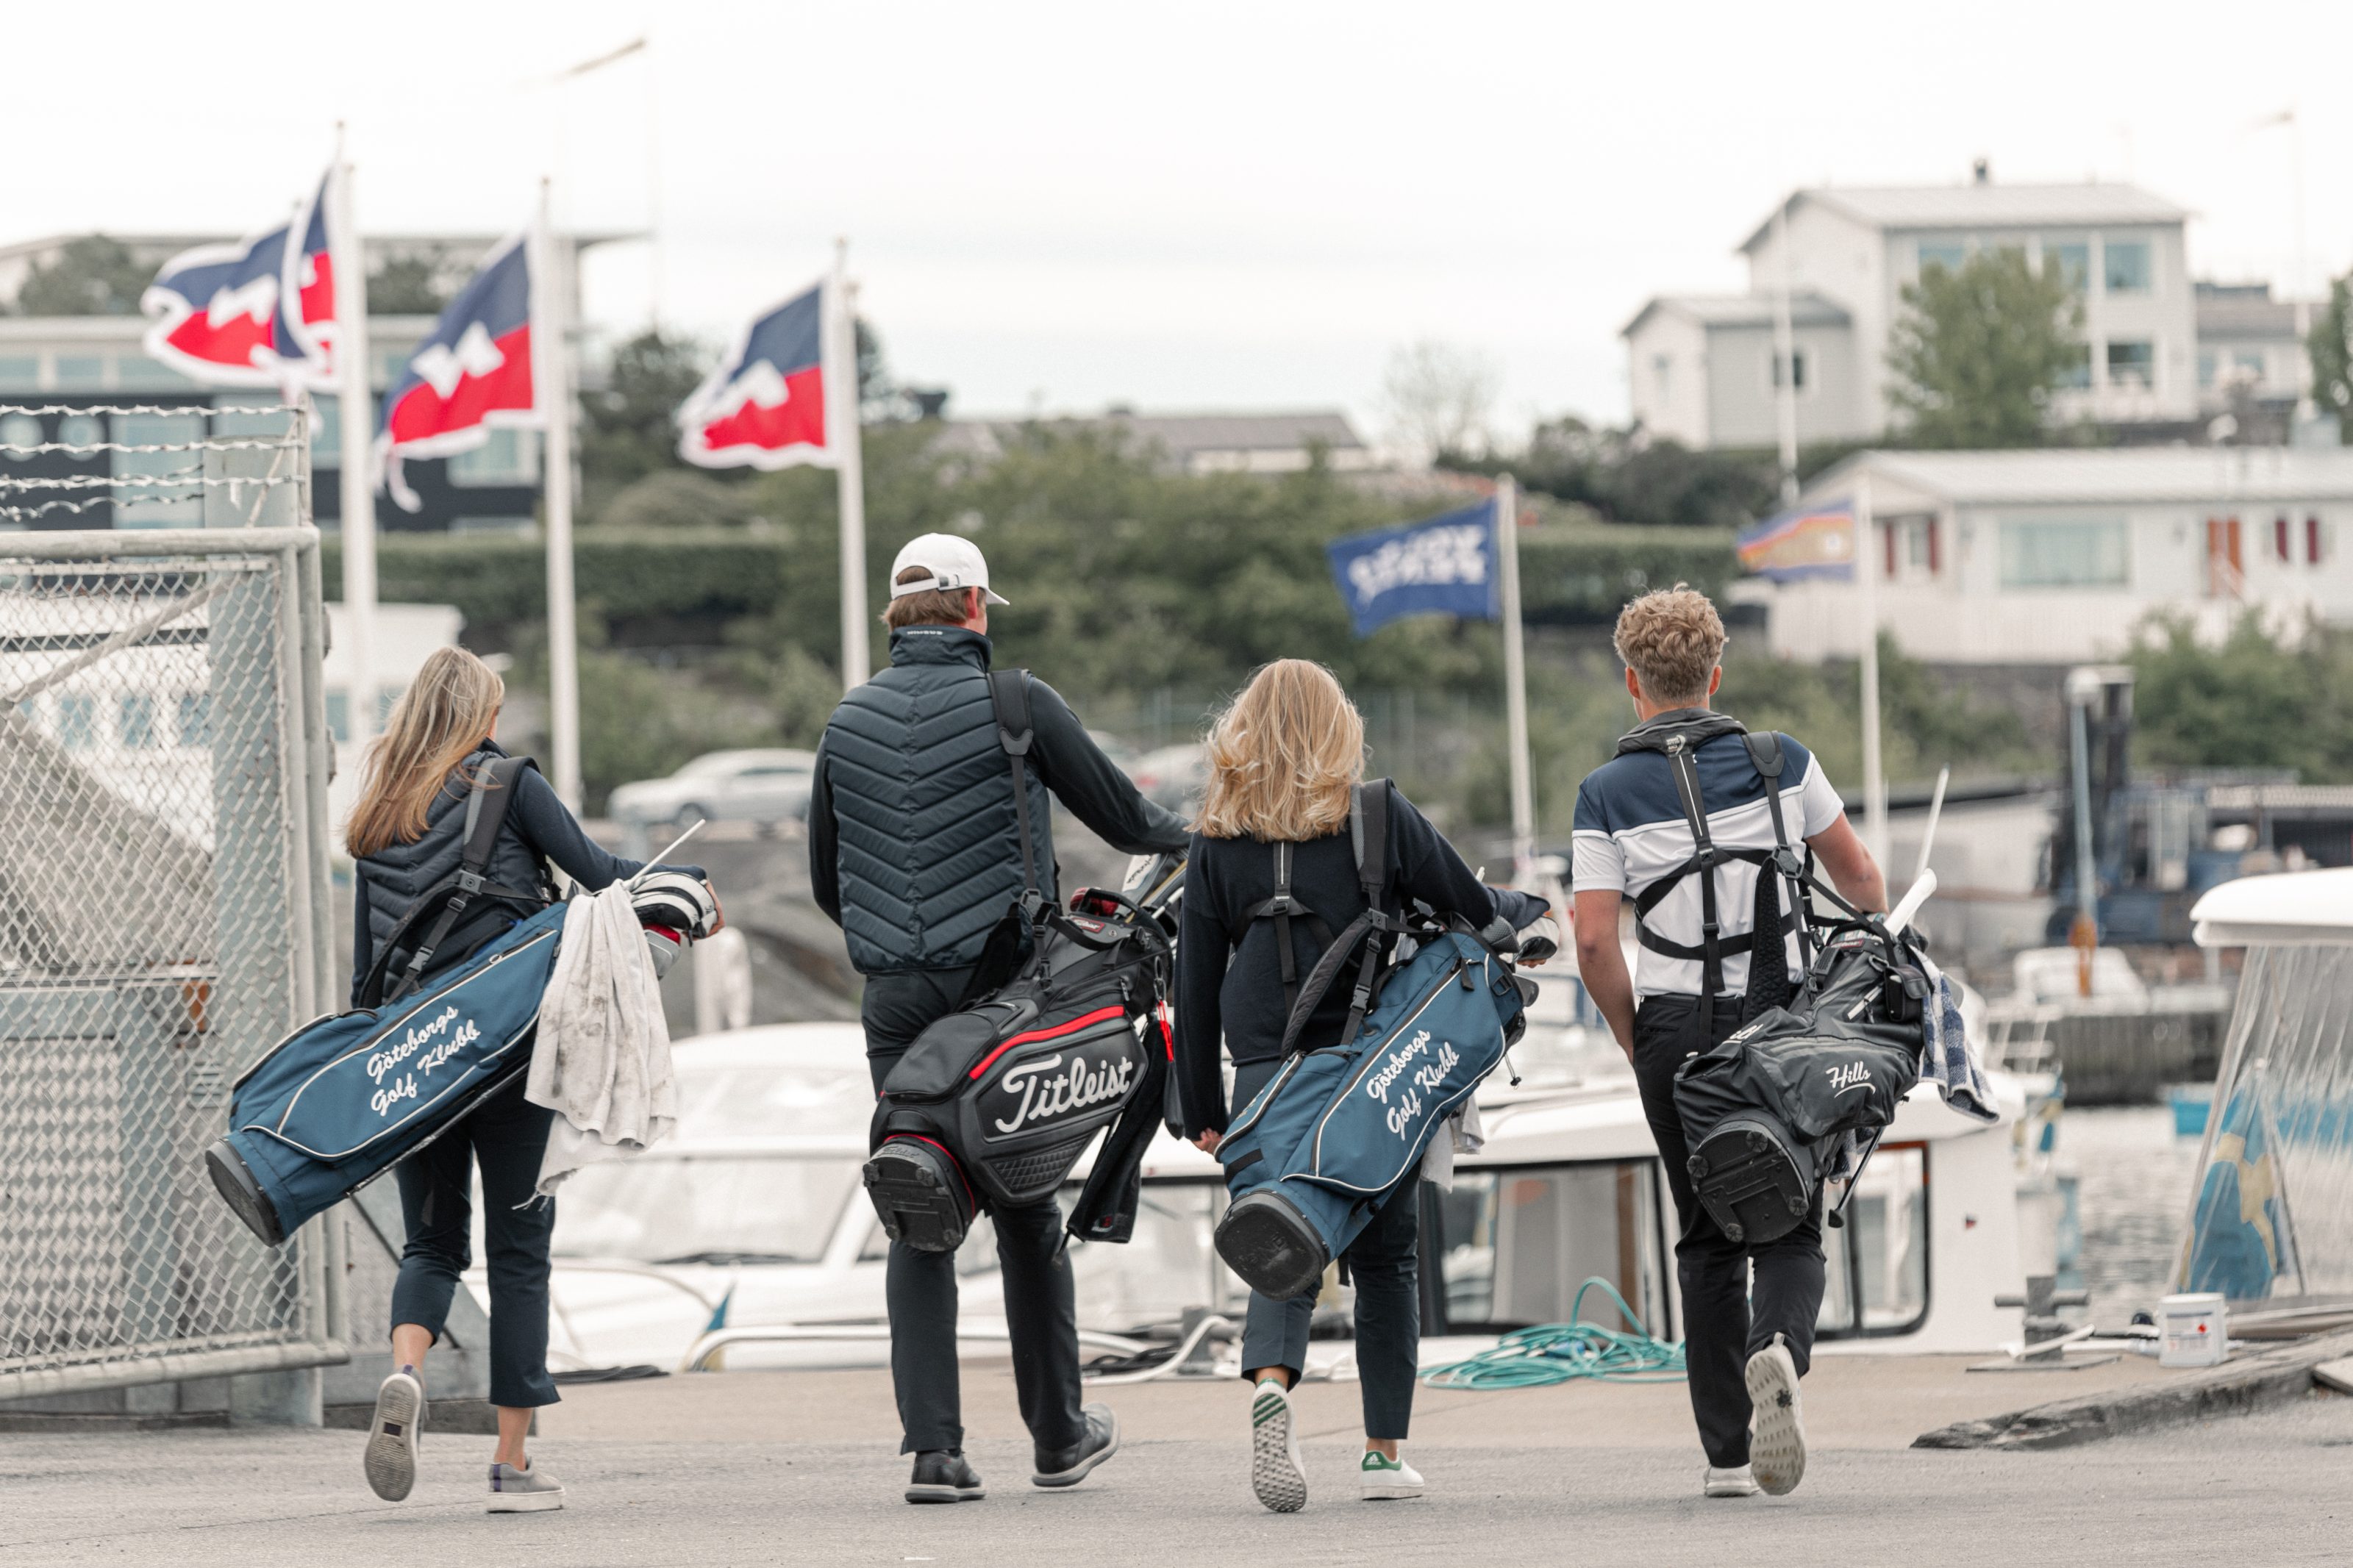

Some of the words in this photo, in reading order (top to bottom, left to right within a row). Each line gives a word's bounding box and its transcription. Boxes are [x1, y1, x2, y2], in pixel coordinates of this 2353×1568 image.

[367, 1006, 459, 1086] Göteborgs
[371, 1073, 418, 1117] Golf
[416, 1019, 482, 1077] Klubb
[1365, 1029, 1431, 1104] Göteborgs
[1825, 1061, 1871, 1089] Hills
[995, 1053, 1133, 1134] Titleist
[1386, 1087, 1422, 1141] Golf
[1413, 1041, 1460, 1095] Klubb
